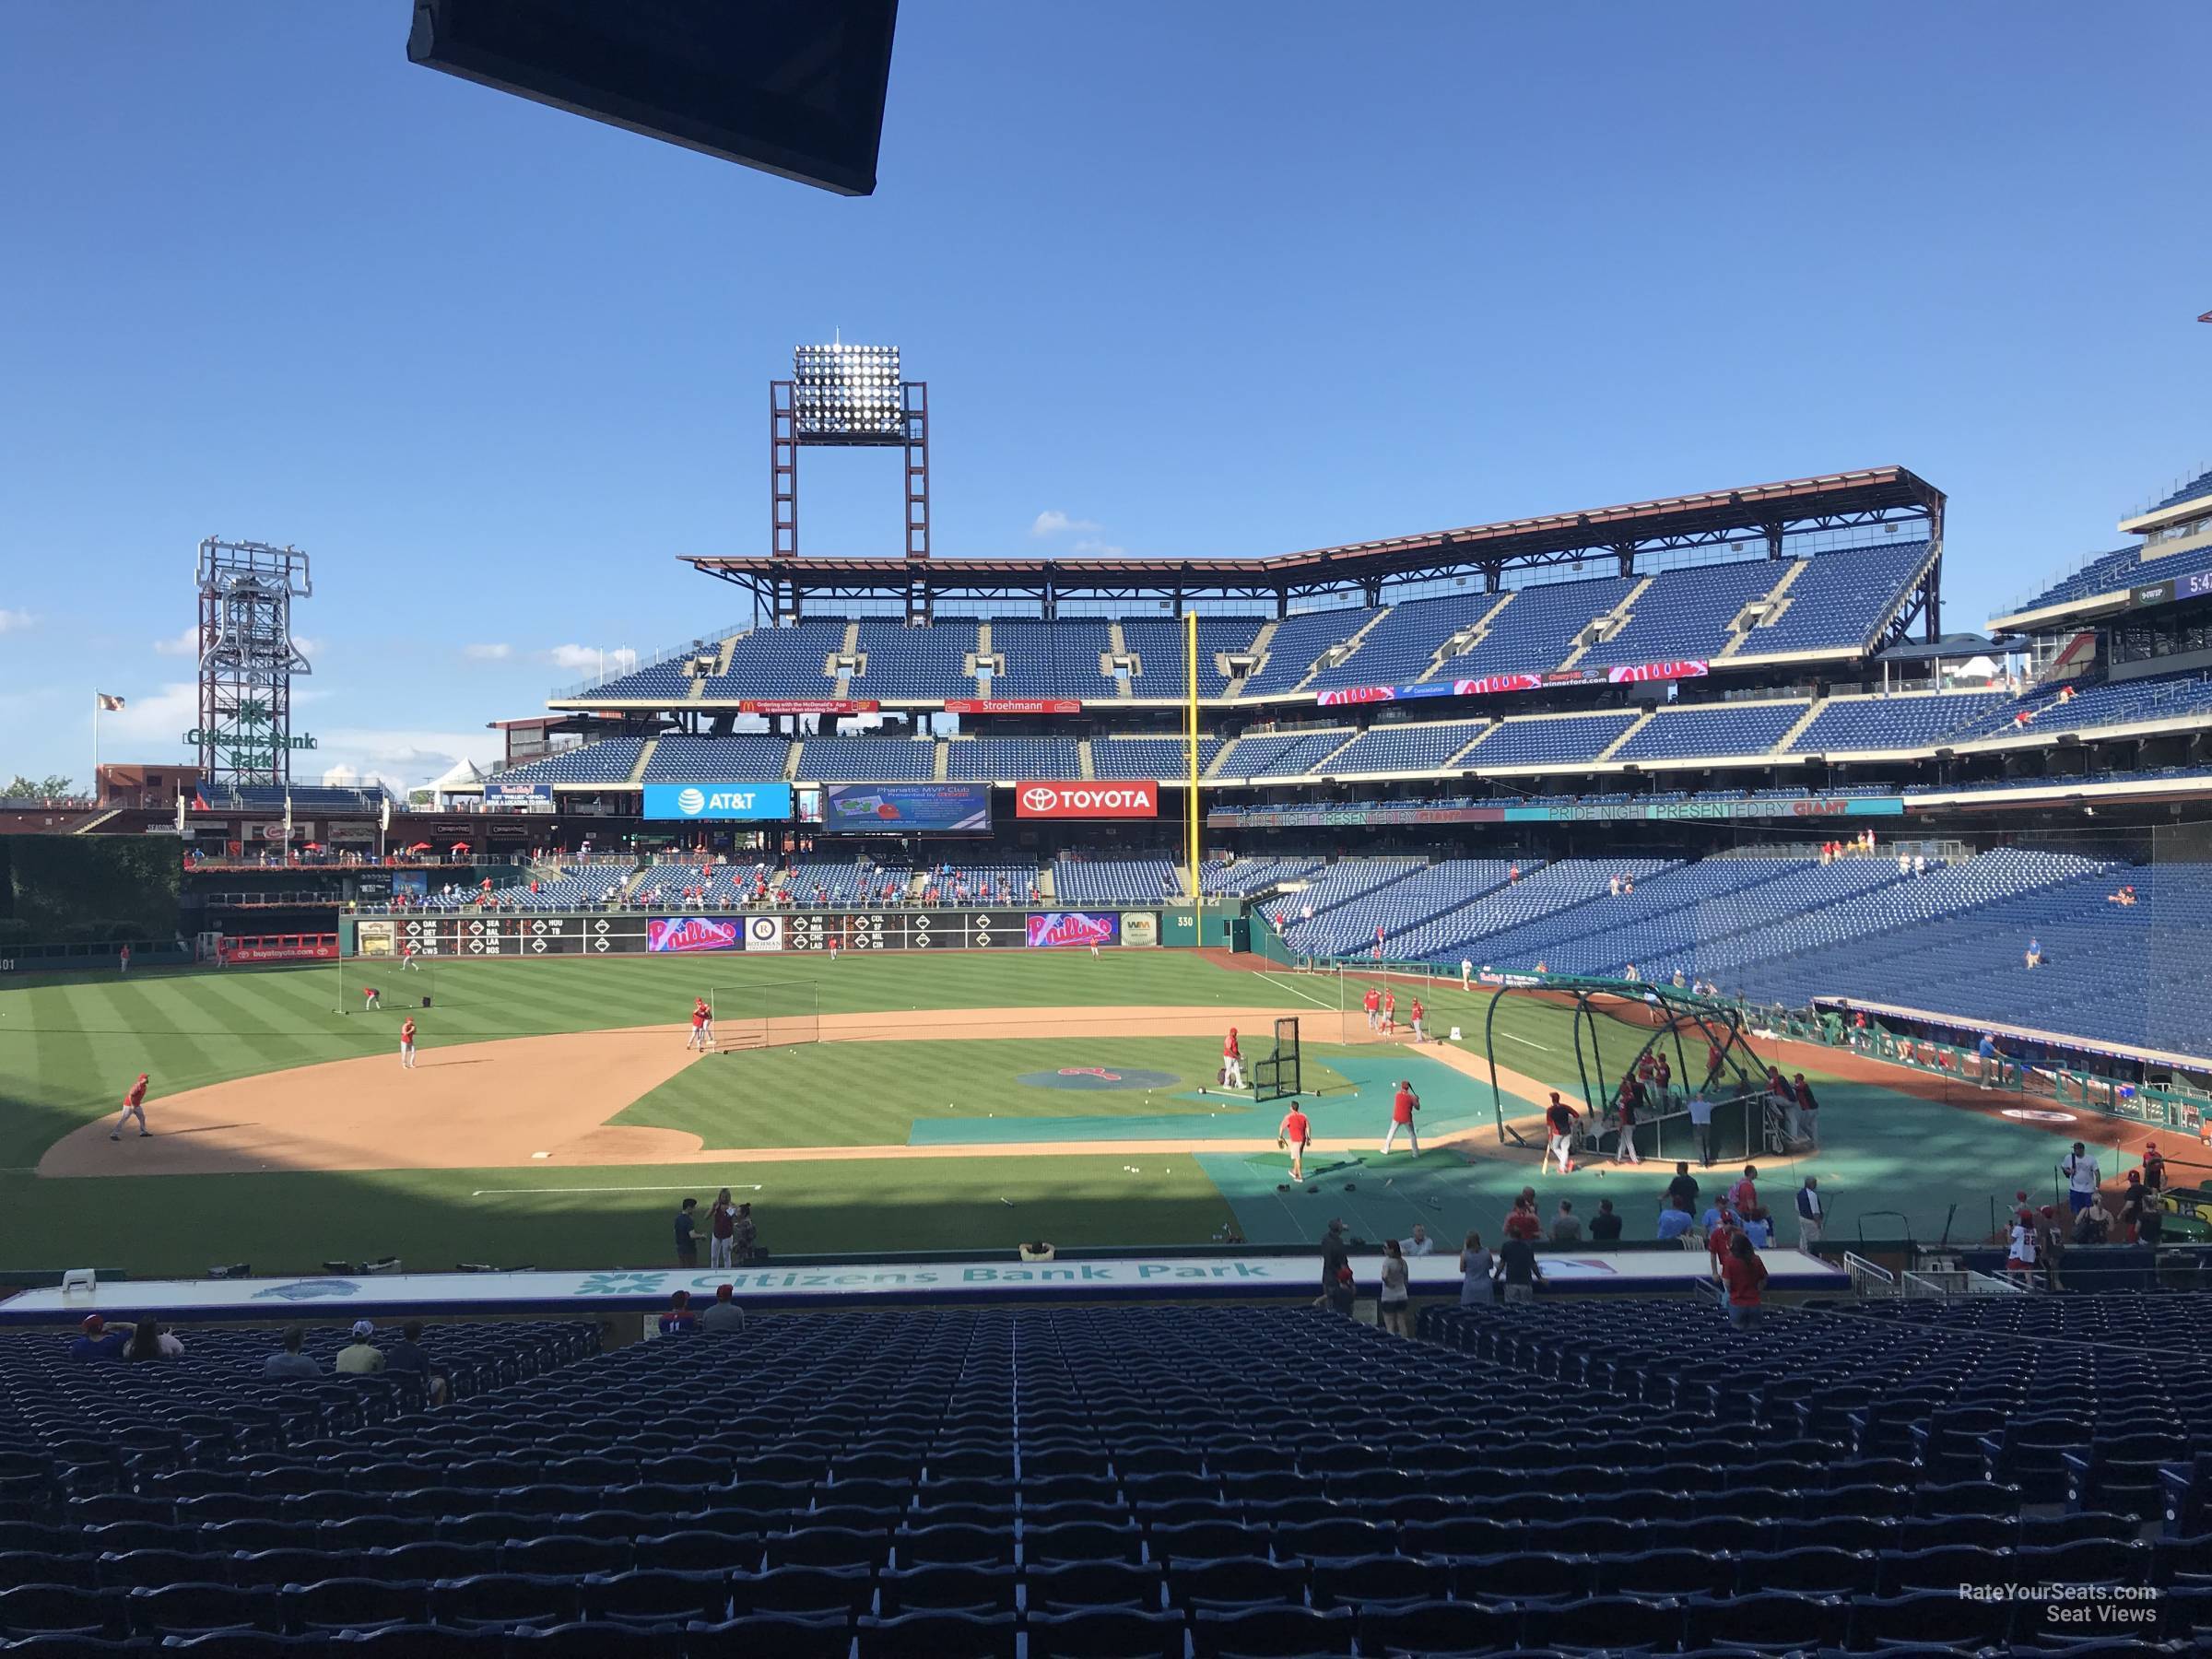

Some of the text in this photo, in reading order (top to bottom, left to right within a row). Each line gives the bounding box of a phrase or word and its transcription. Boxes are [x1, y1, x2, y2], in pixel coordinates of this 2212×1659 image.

[1542, 677, 1607, 688] winnerford.com
[982, 700, 1042, 710] Stroehmann
[187, 728, 315, 749] Citizens Bank
[231, 751, 273, 768] Park
[709, 793, 756, 810] AT&T
[1060, 790, 1150, 808] TOYOTA
[1548, 801, 1848, 820] PRIDE NIGHT PRESENTED BY GIANT
[1236, 815, 1272, 827] PRIDE
[1276, 814, 1312, 826] NIGHT
[1318, 812, 1394, 825] PRESENTED
[1398, 811, 1417, 823] BY
[760, 924, 768, 933] R
[1177, 916, 1194, 927] 330
[253, 948, 313, 958] buyatoyota.com
[691, 1262, 1270, 1288] Citizens Bank Park
